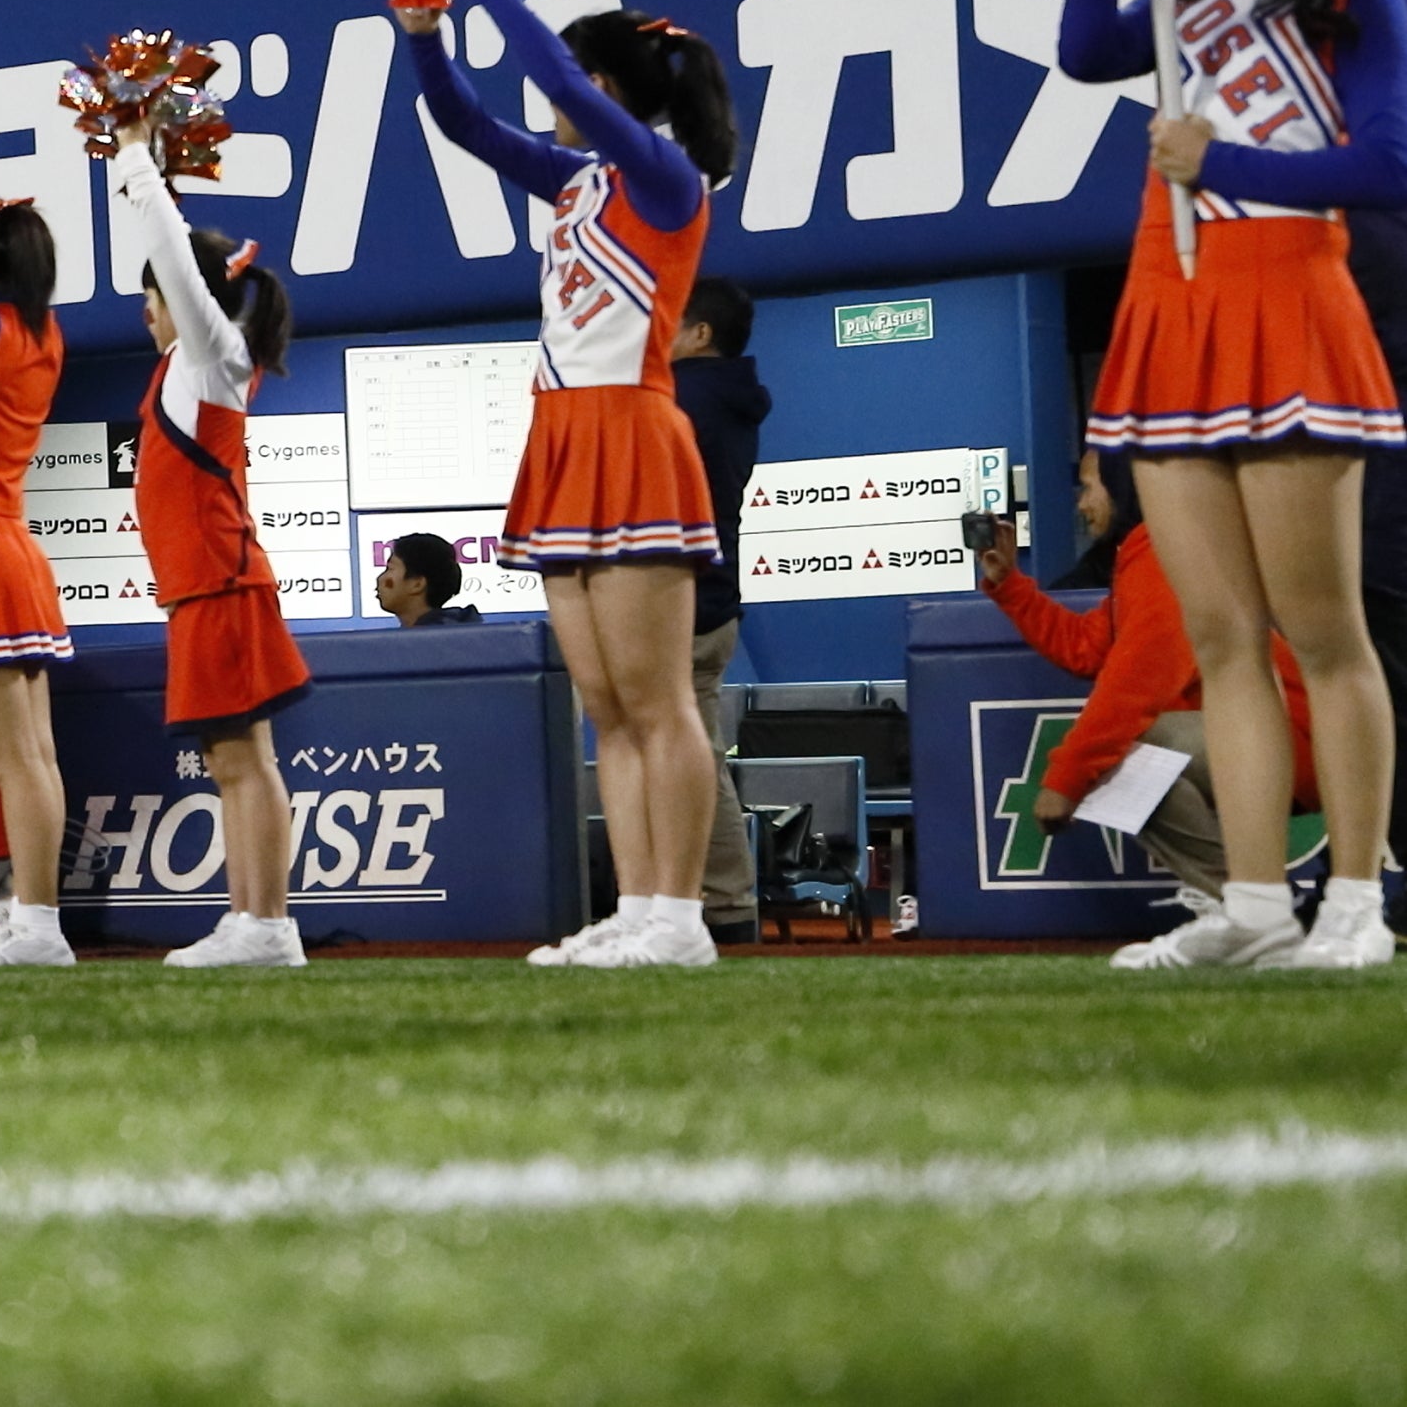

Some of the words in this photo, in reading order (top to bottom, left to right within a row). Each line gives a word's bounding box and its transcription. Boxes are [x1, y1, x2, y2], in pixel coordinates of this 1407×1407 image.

[257, 442, 341, 462] Cygames
[776, 485, 851, 505] ミツウロコ
[885, 477, 962, 498] ミツウロコ
[29, 517, 108, 536] ミツウロコ
[261, 510, 342, 528] ミツウロコ
[777, 554, 853, 575] ミツウロコ
[888, 547, 965, 569] ミツウロコ
[57, 582, 110, 601] ウロコ
[278, 577, 343, 594] ツウロコ
[290, 742, 443, 776] ベンハウス
